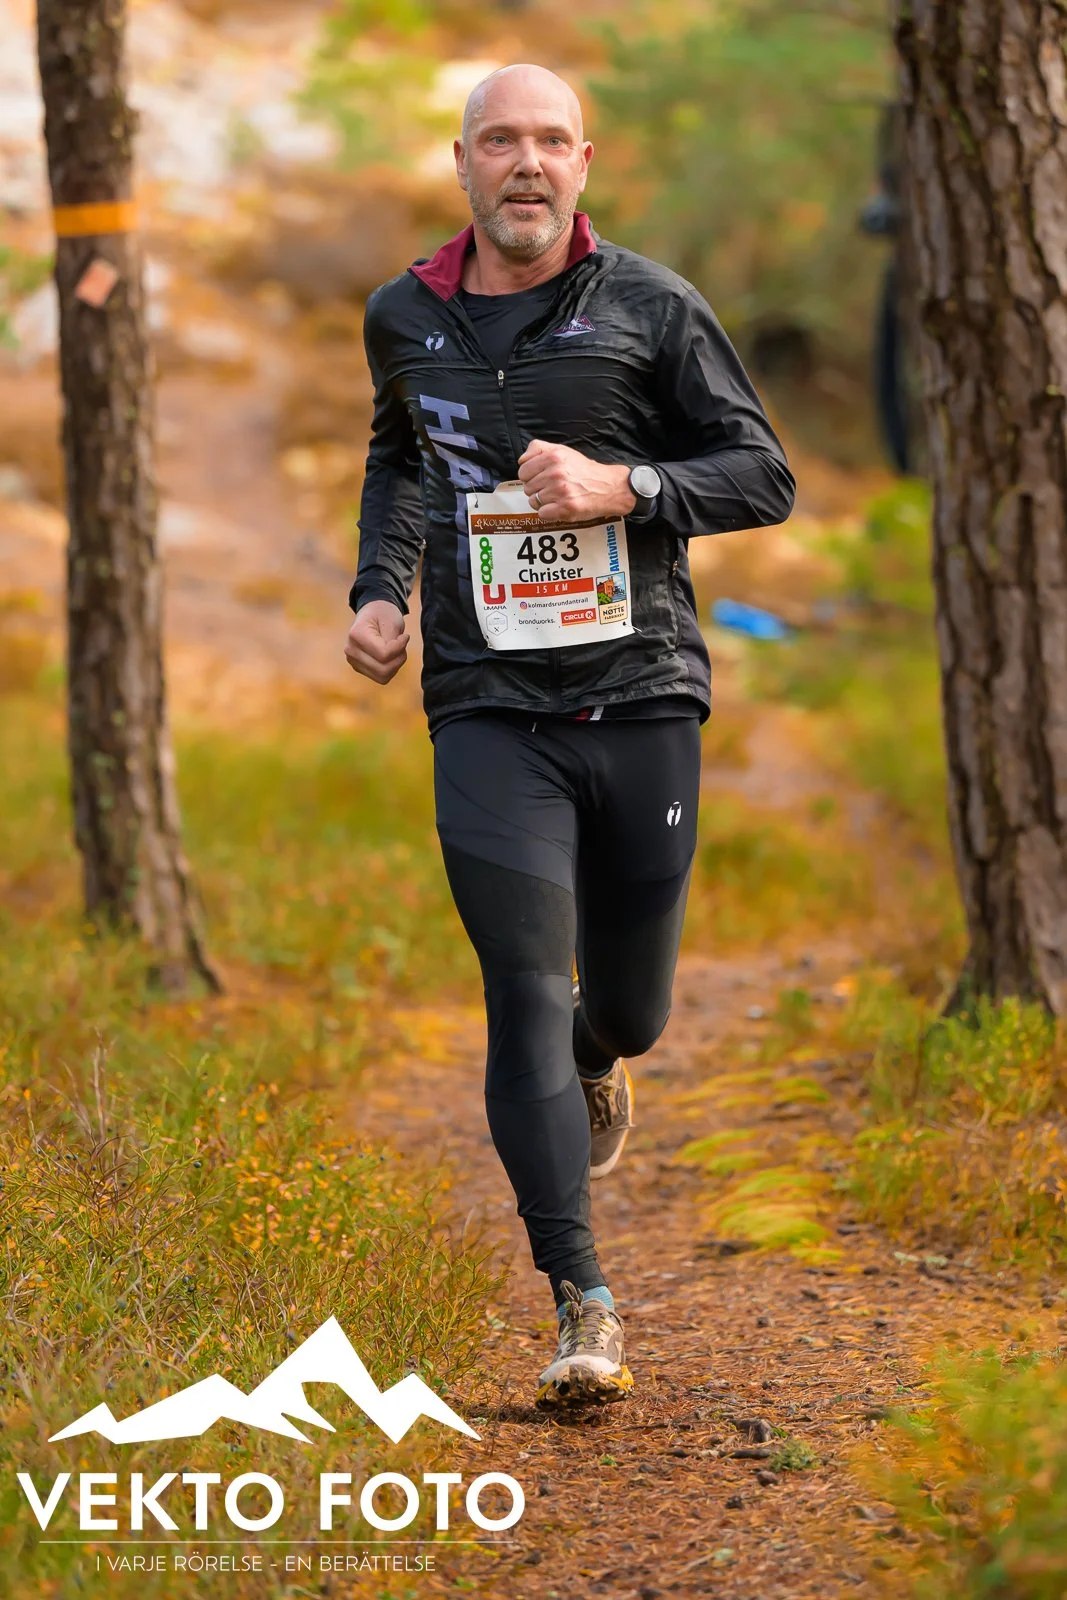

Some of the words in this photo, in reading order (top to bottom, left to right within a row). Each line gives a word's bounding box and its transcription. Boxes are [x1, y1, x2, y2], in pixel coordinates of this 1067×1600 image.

[517, 533, 580, 565] 483
[606, 524, 619, 572] Aktivitus
[479, 536, 493, 585] coop
[518, 567, 584, 583] Christer
[536, 585, 547, 594] 15
[554, 583, 569, 593] KM
[527, 597, 589, 609] kolmardsrundantrail
[563, 613, 585, 621] CIRCLE
